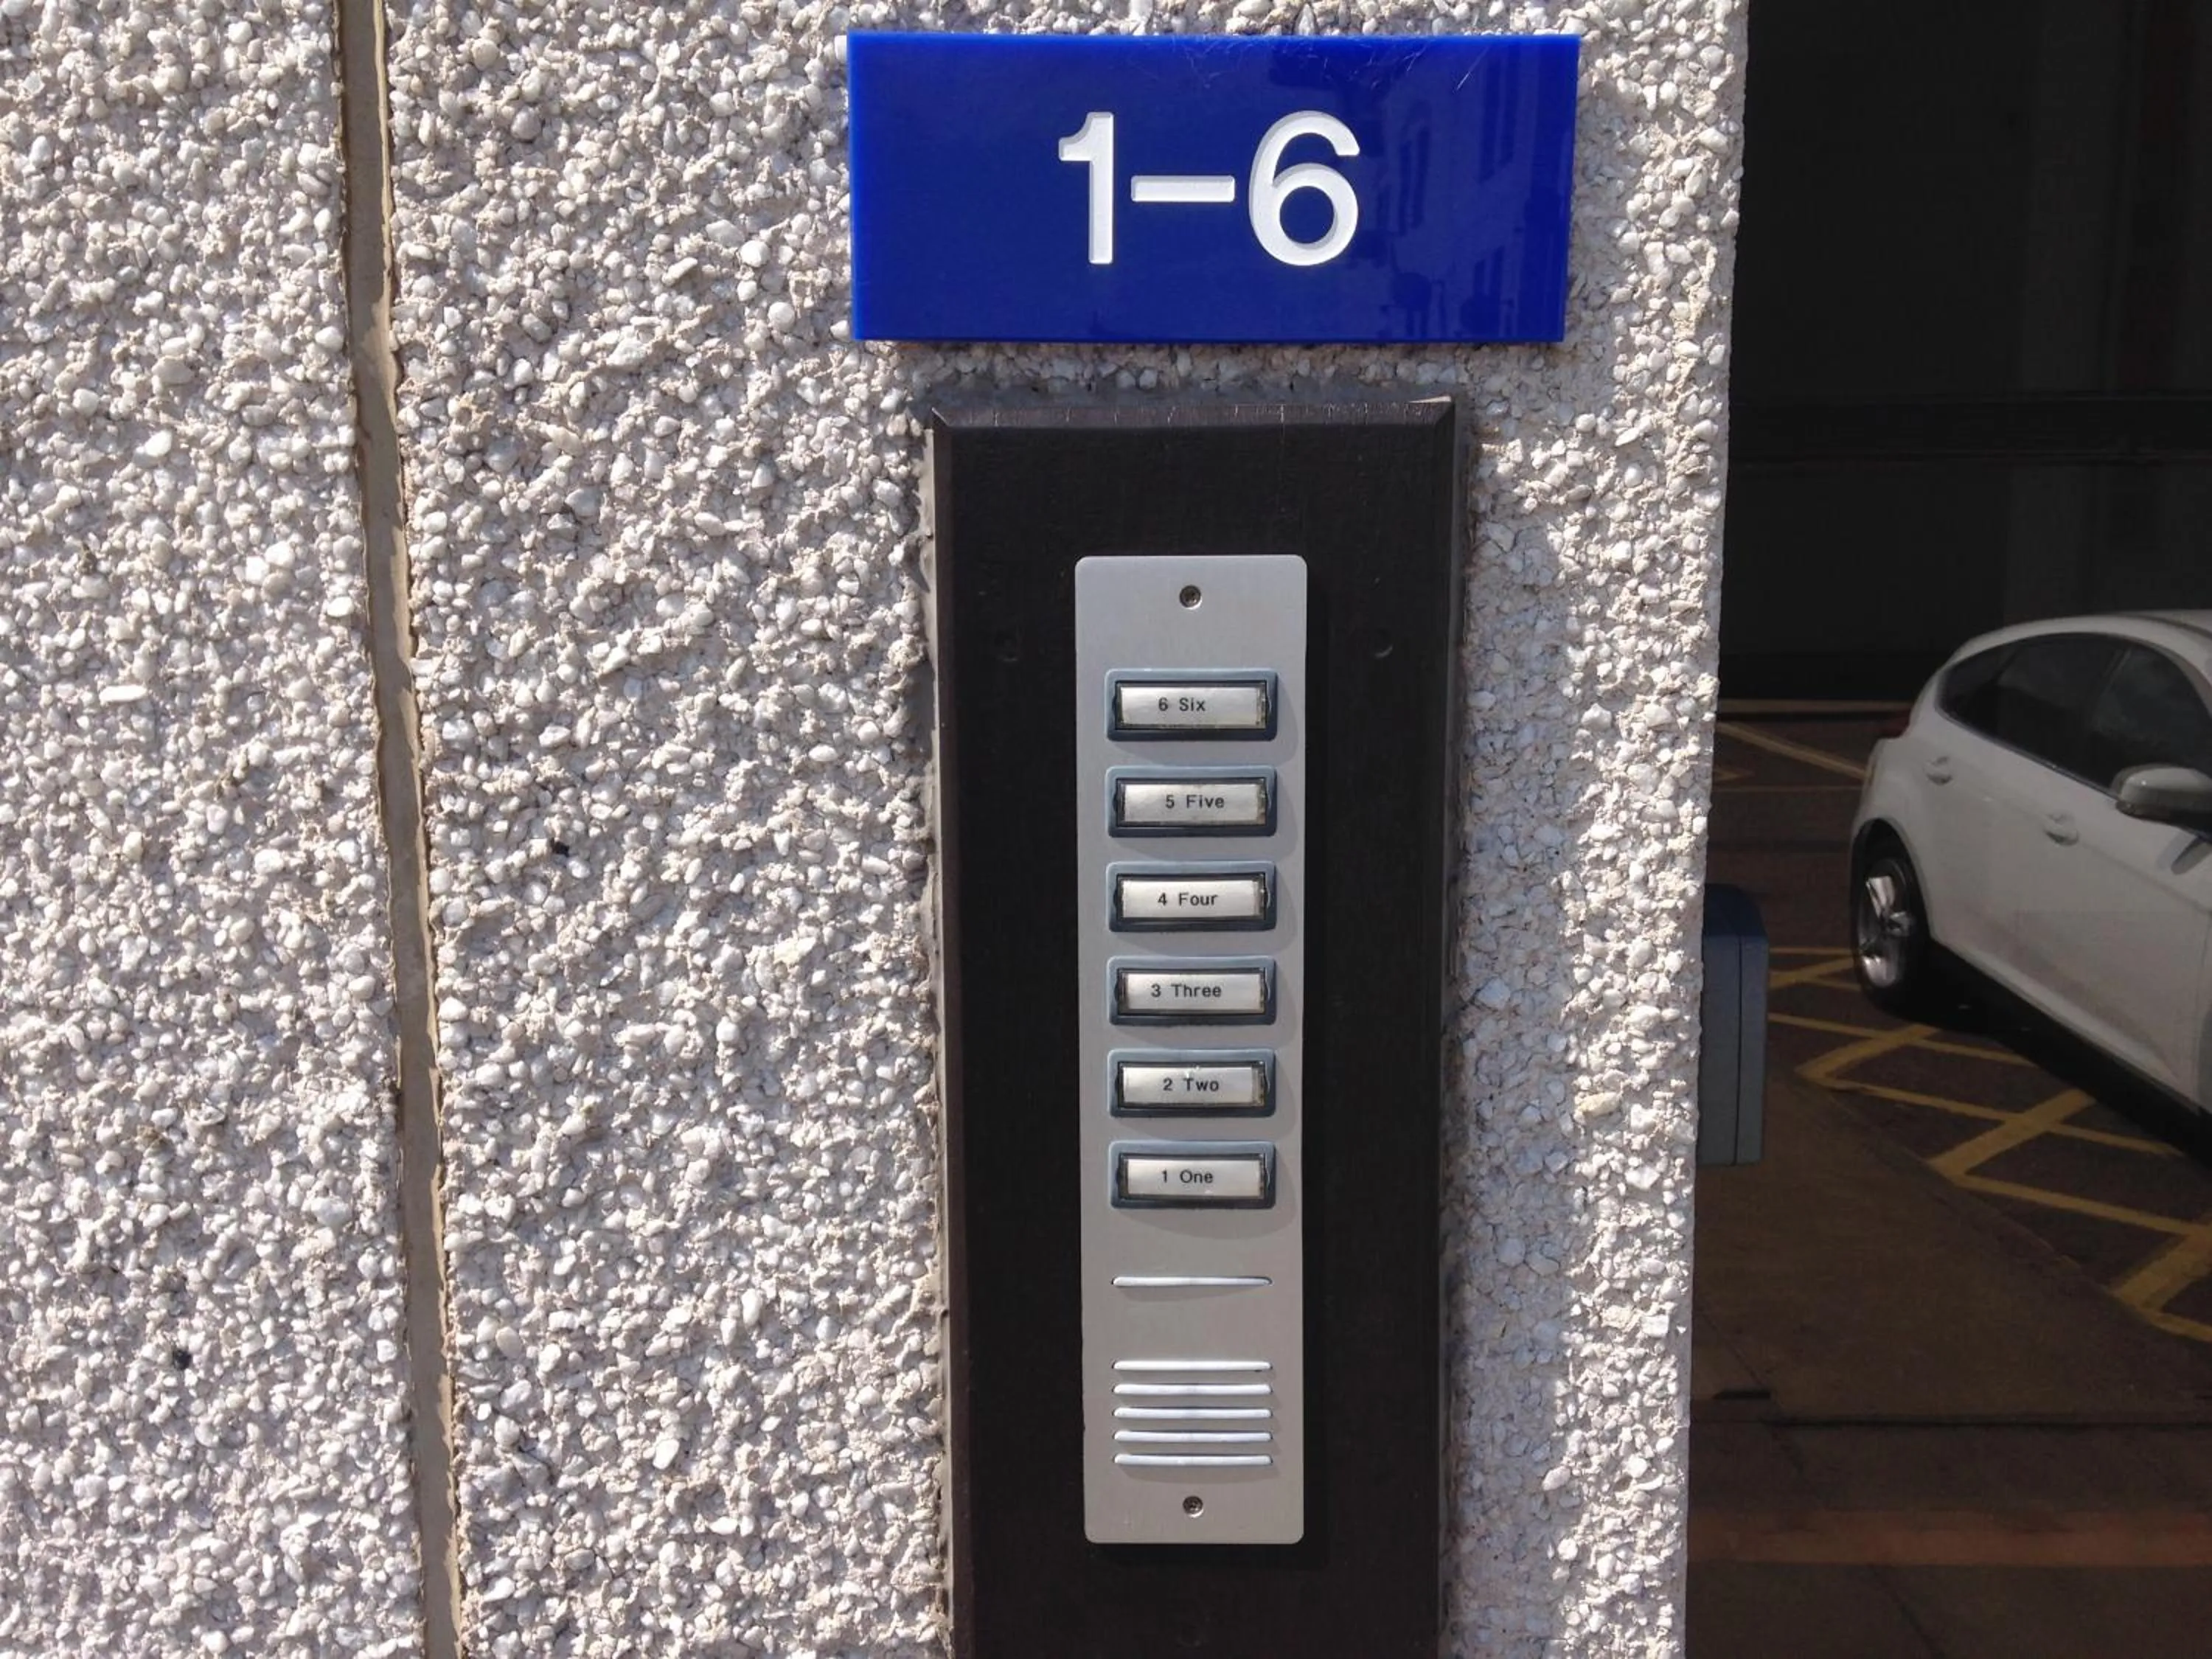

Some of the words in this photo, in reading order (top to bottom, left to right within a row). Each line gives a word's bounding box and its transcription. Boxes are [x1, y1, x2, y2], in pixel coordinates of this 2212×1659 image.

[1058, 110, 1360, 266] 1-6
[1158, 697, 1169, 712] 6
[1178, 697, 1206, 712] Six
[1164, 794, 1175, 810] 5
[1186, 794, 1225, 810] Five
[1157, 892, 1168, 907] 4
[1178, 892, 1218, 908] Four
[1150, 983, 1163, 998] 3
[1170, 983, 1222, 999] Three
[1162, 1077, 1174, 1092] 2
[1182, 1077, 1220, 1093] Two
[1161, 1169, 1169, 1184] 1
[1179, 1169, 1214, 1185] One
